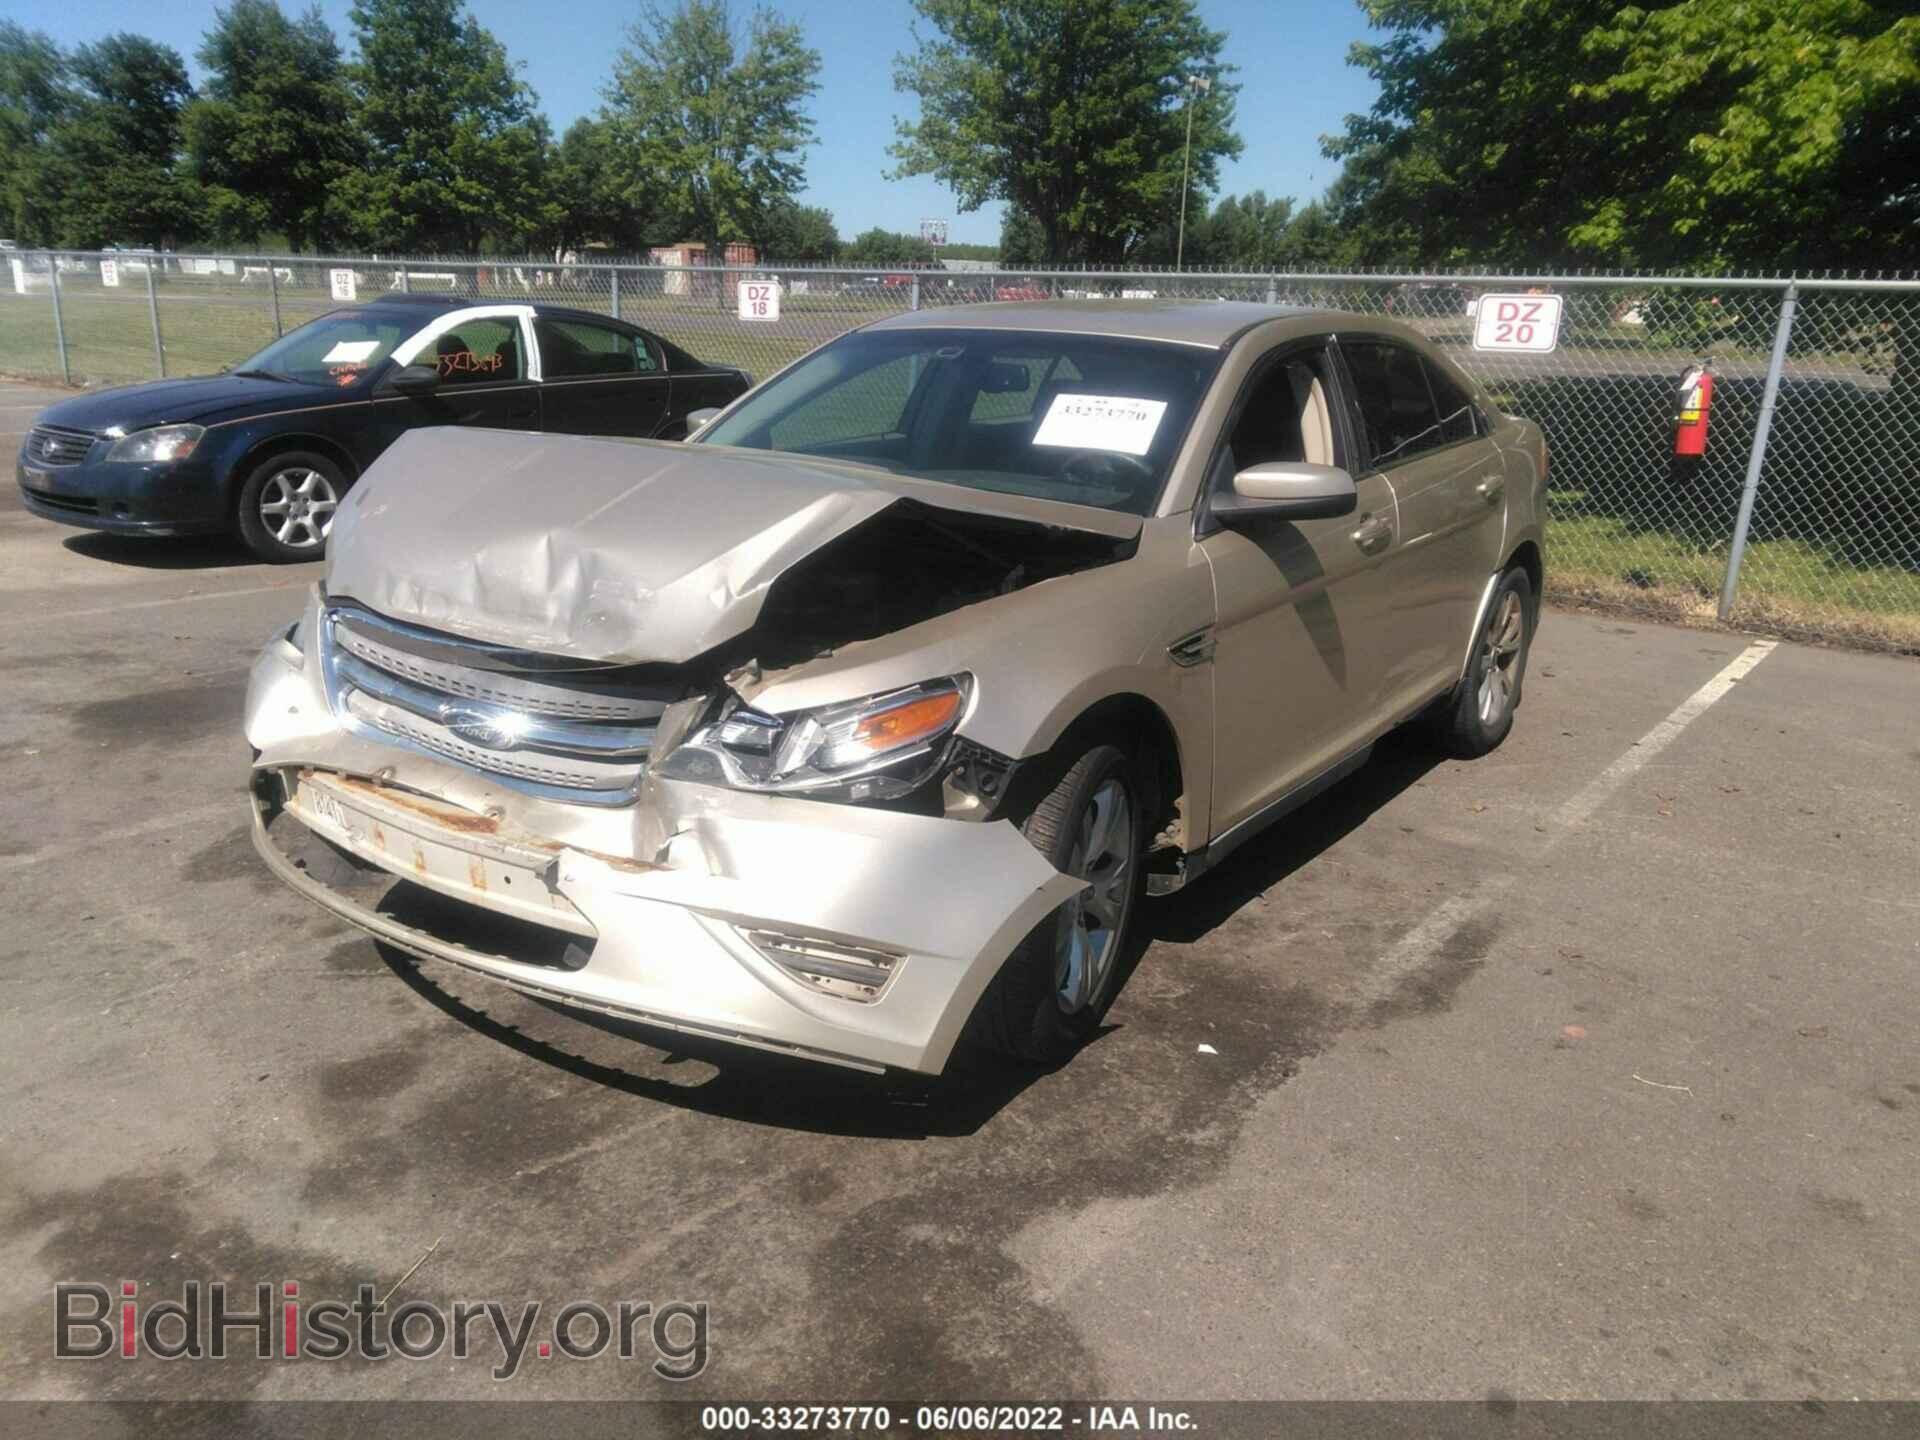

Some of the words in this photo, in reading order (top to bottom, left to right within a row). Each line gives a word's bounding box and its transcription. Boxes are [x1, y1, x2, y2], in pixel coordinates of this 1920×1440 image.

[748, 286, 770, 301] DZ
[752, 302, 767, 316] 18
[1497, 302, 1543, 323] DZ
[1495, 323, 1533, 343] 20
